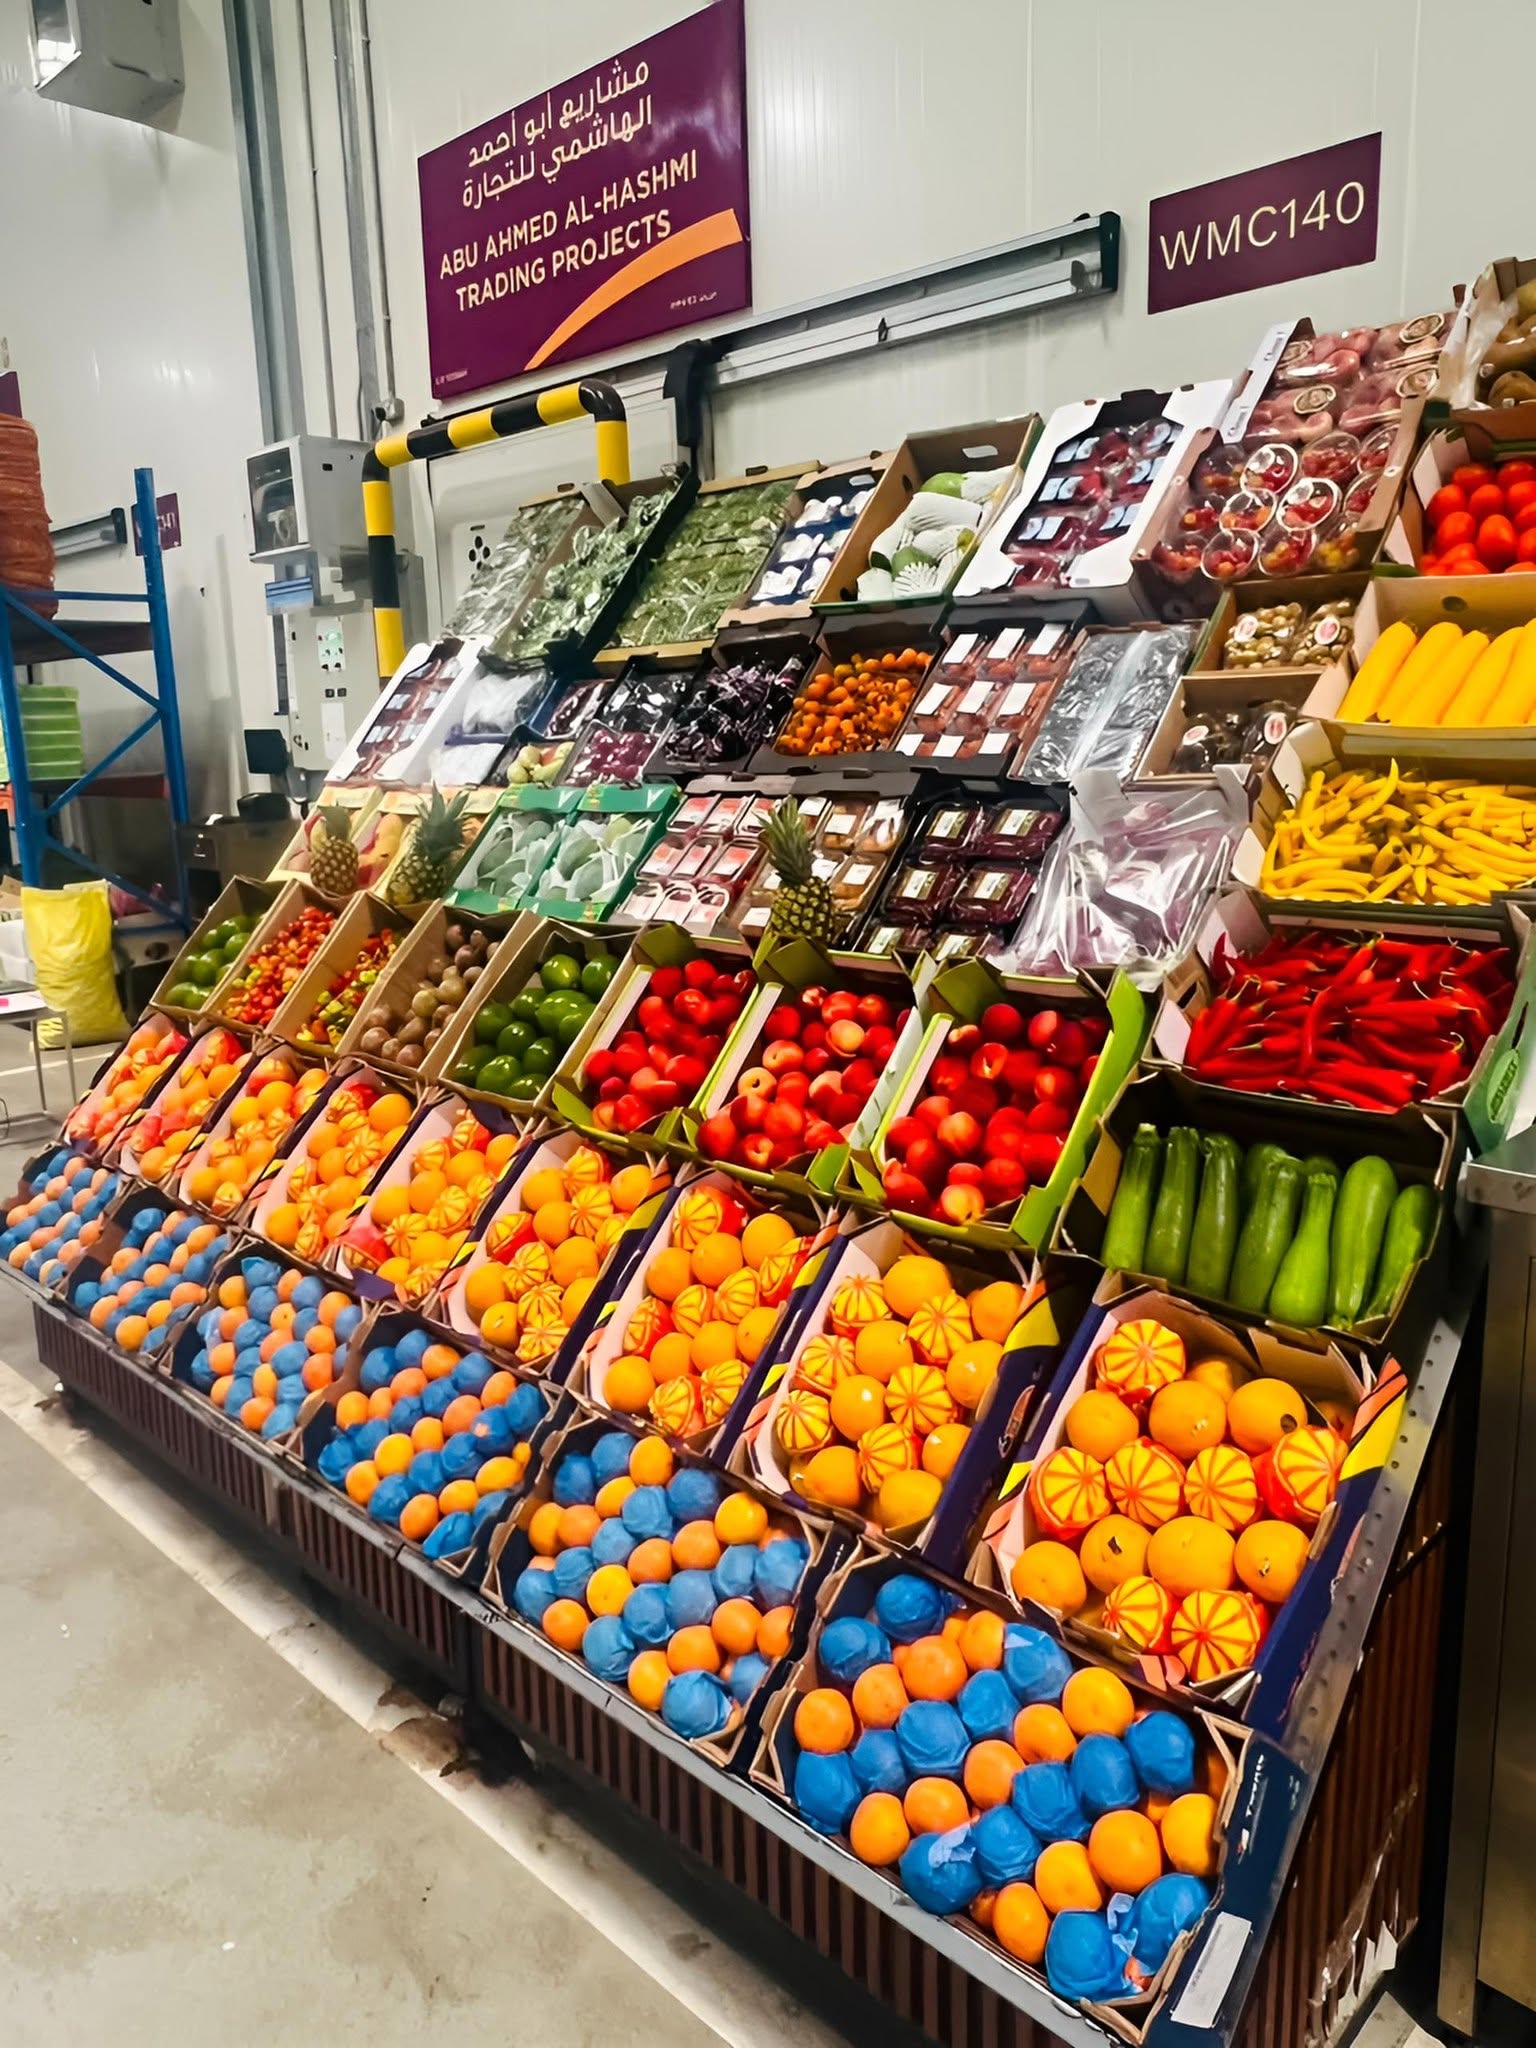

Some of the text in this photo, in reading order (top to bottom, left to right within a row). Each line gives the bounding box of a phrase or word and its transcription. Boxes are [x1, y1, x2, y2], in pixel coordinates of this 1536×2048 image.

[559, 59, 649, 129] مشاريع
[462, 94, 652, 209] الهاشمي للتجارة
[440, 149, 698, 279] ABU AHMED AL-HASHMI
[456, 209, 672, 312] TRADING PROJECTS
[1159, 181, 1365, 270] WMC140
